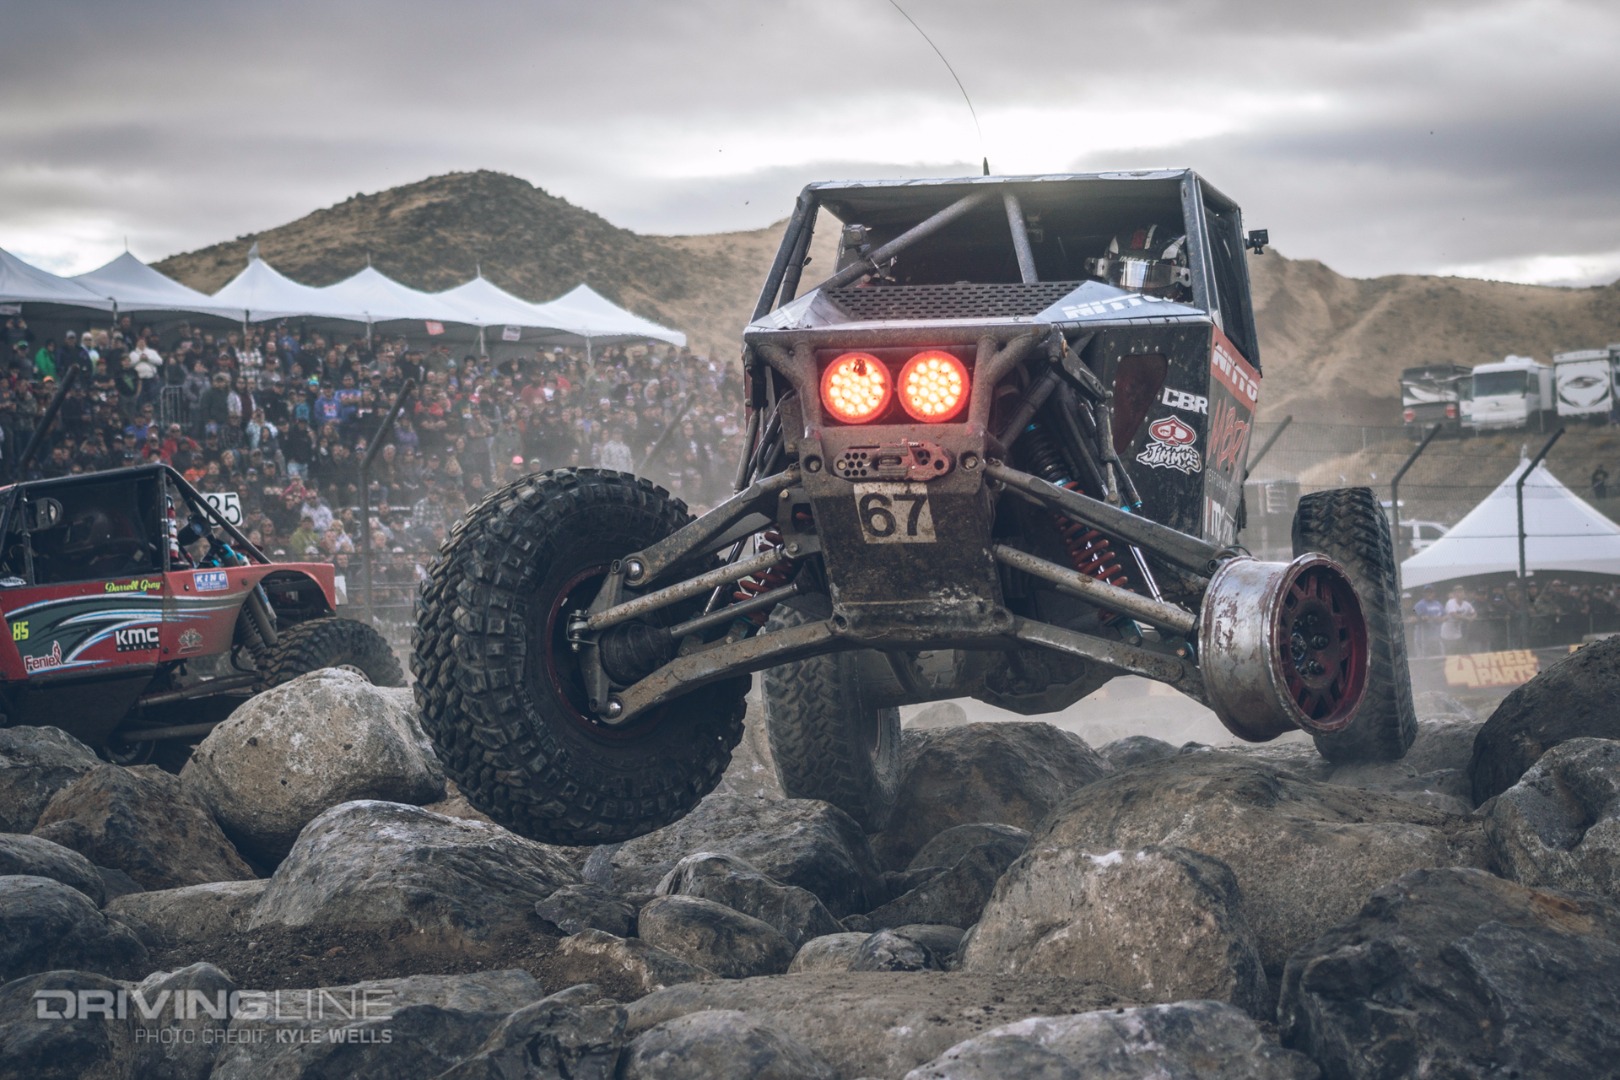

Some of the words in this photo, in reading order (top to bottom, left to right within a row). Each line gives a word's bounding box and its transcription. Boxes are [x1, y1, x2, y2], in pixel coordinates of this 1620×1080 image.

[1212, 344, 1258, 402] NITTO
[1161, 387, 1208, 415] CBR
[859, 493, 928, 537] 67
[196, 573, 225, 583] KING
[13, 621, 29, 641] 85
[115, 627, 160, 646] KMC
[1444, 654, 1479, 687] 4
[1470, 649, 1537, 669] WHEEL
[1477, 664, 1538, 686] PARTS
